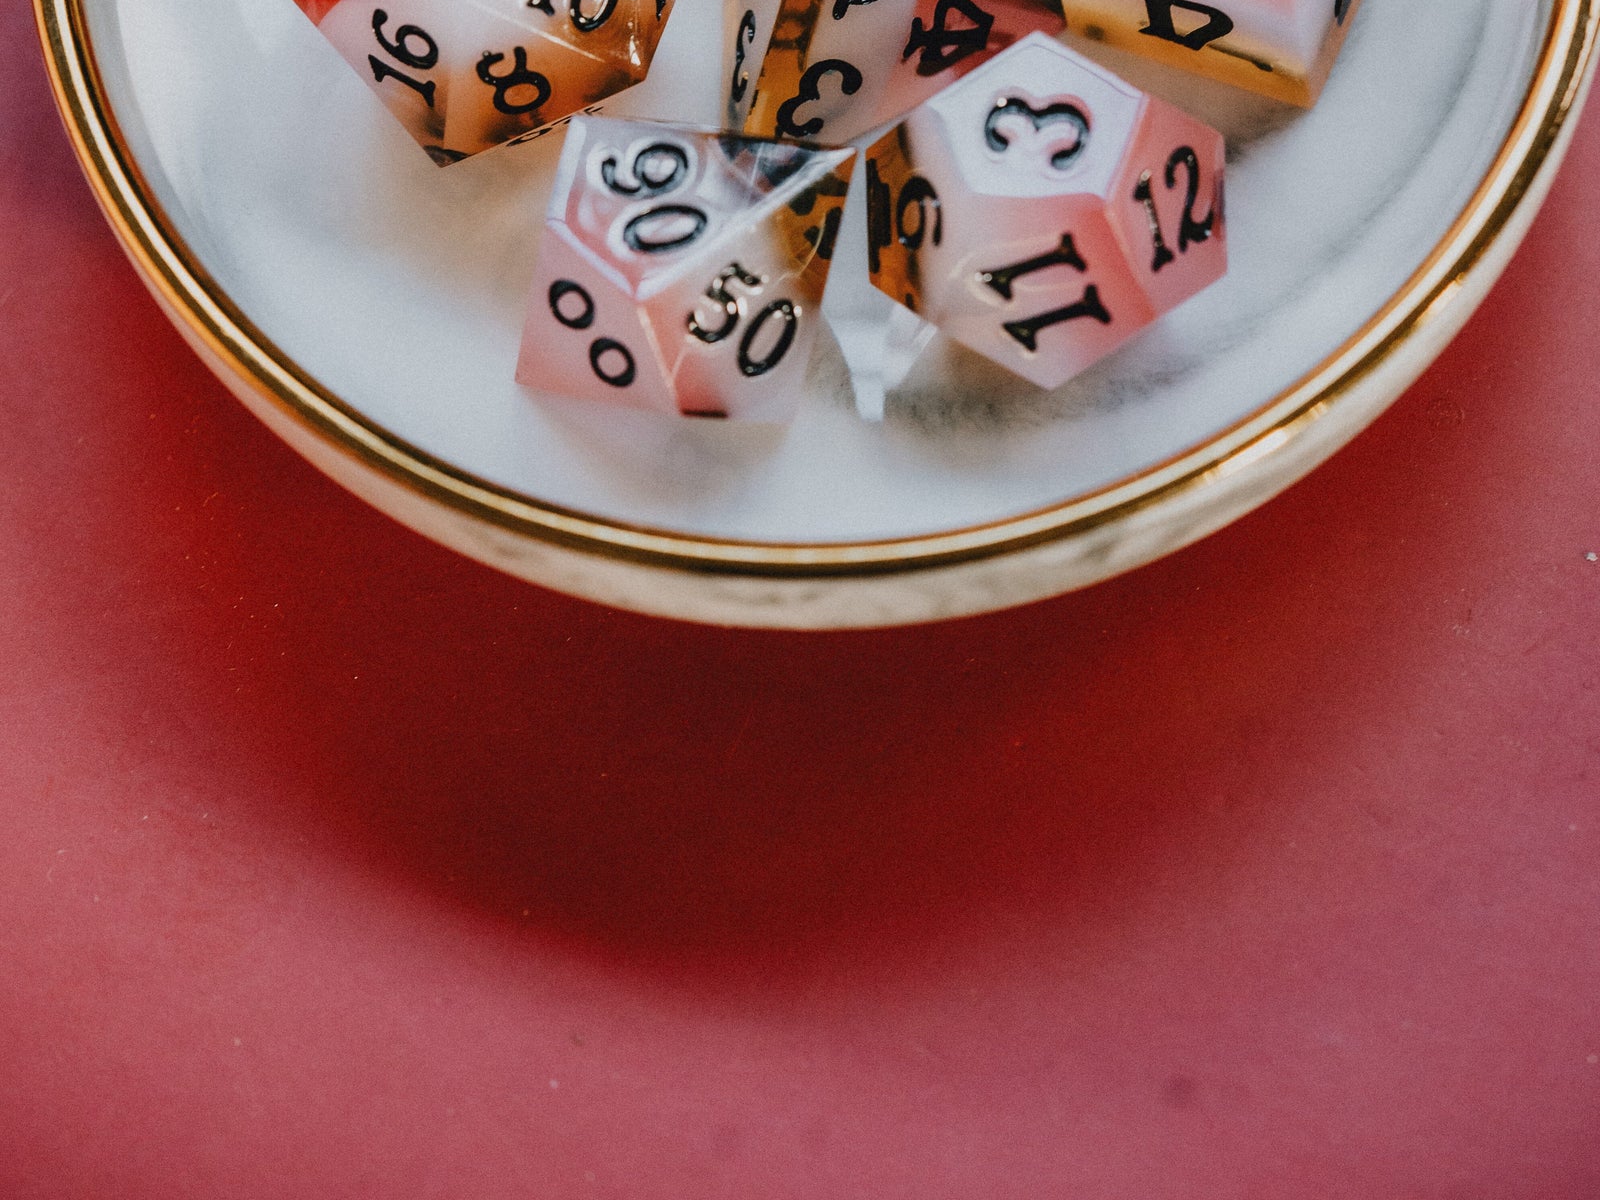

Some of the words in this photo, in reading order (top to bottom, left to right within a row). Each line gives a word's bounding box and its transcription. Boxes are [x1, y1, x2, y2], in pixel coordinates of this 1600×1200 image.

[367, 8, 439, 108] 16
[475, 46, 552, 114] 8
[776, 58, 863, 138] 3
[984, 97, 1090, 170] 3
[1133, 146, 1214, 273] 12
[686, 262, 799, 379] 50
[977, 232, 1111, 352] 11
